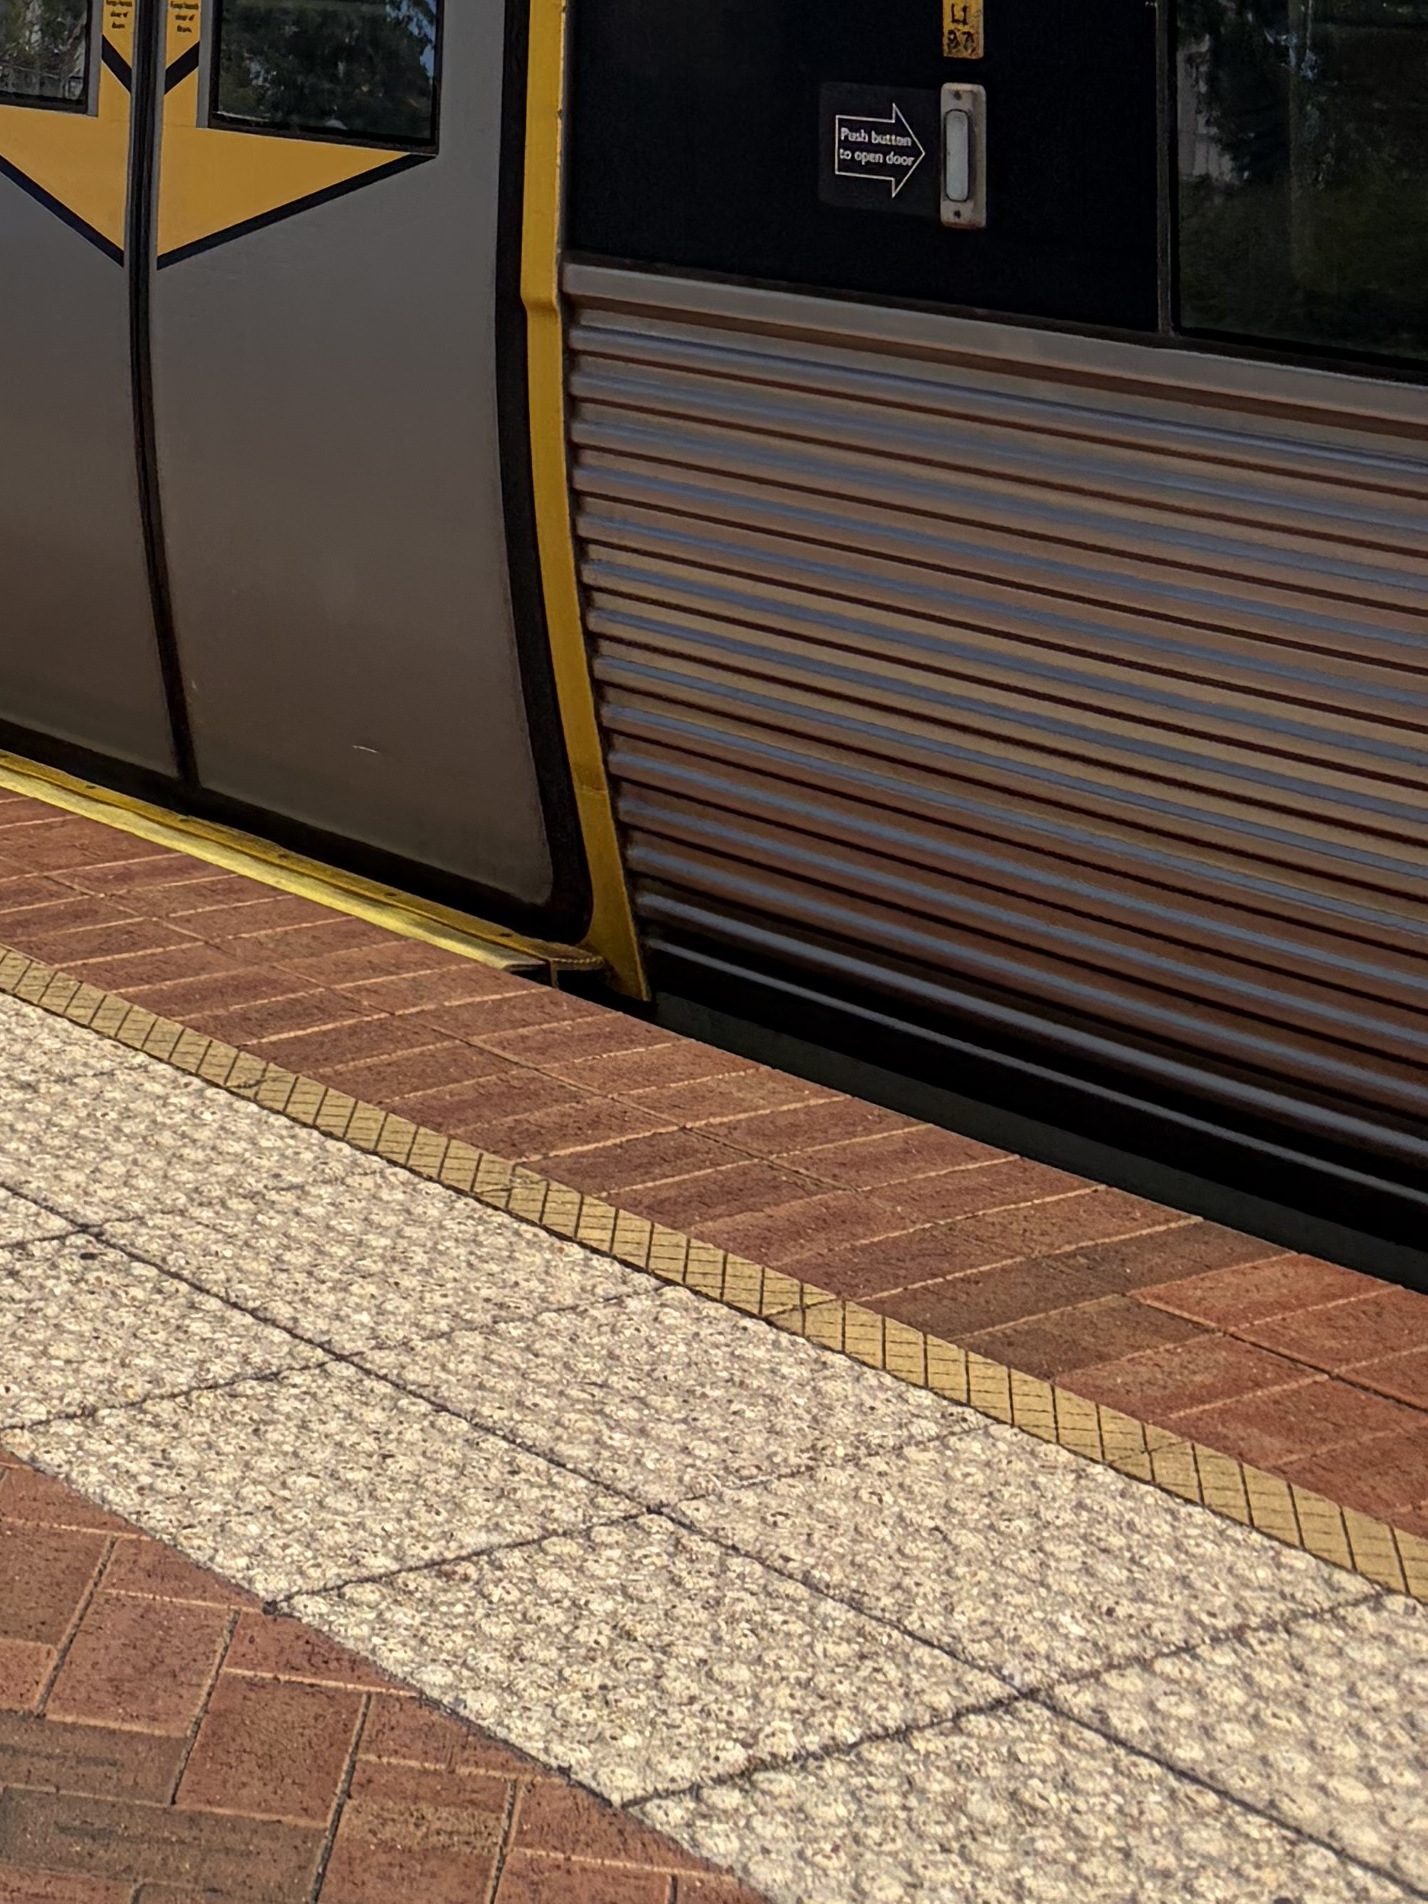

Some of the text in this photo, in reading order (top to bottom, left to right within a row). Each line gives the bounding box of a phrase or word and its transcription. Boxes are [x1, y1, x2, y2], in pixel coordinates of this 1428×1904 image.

[840, 127, 912, 146] Push button
[839, 149, 915, 166] to open door
